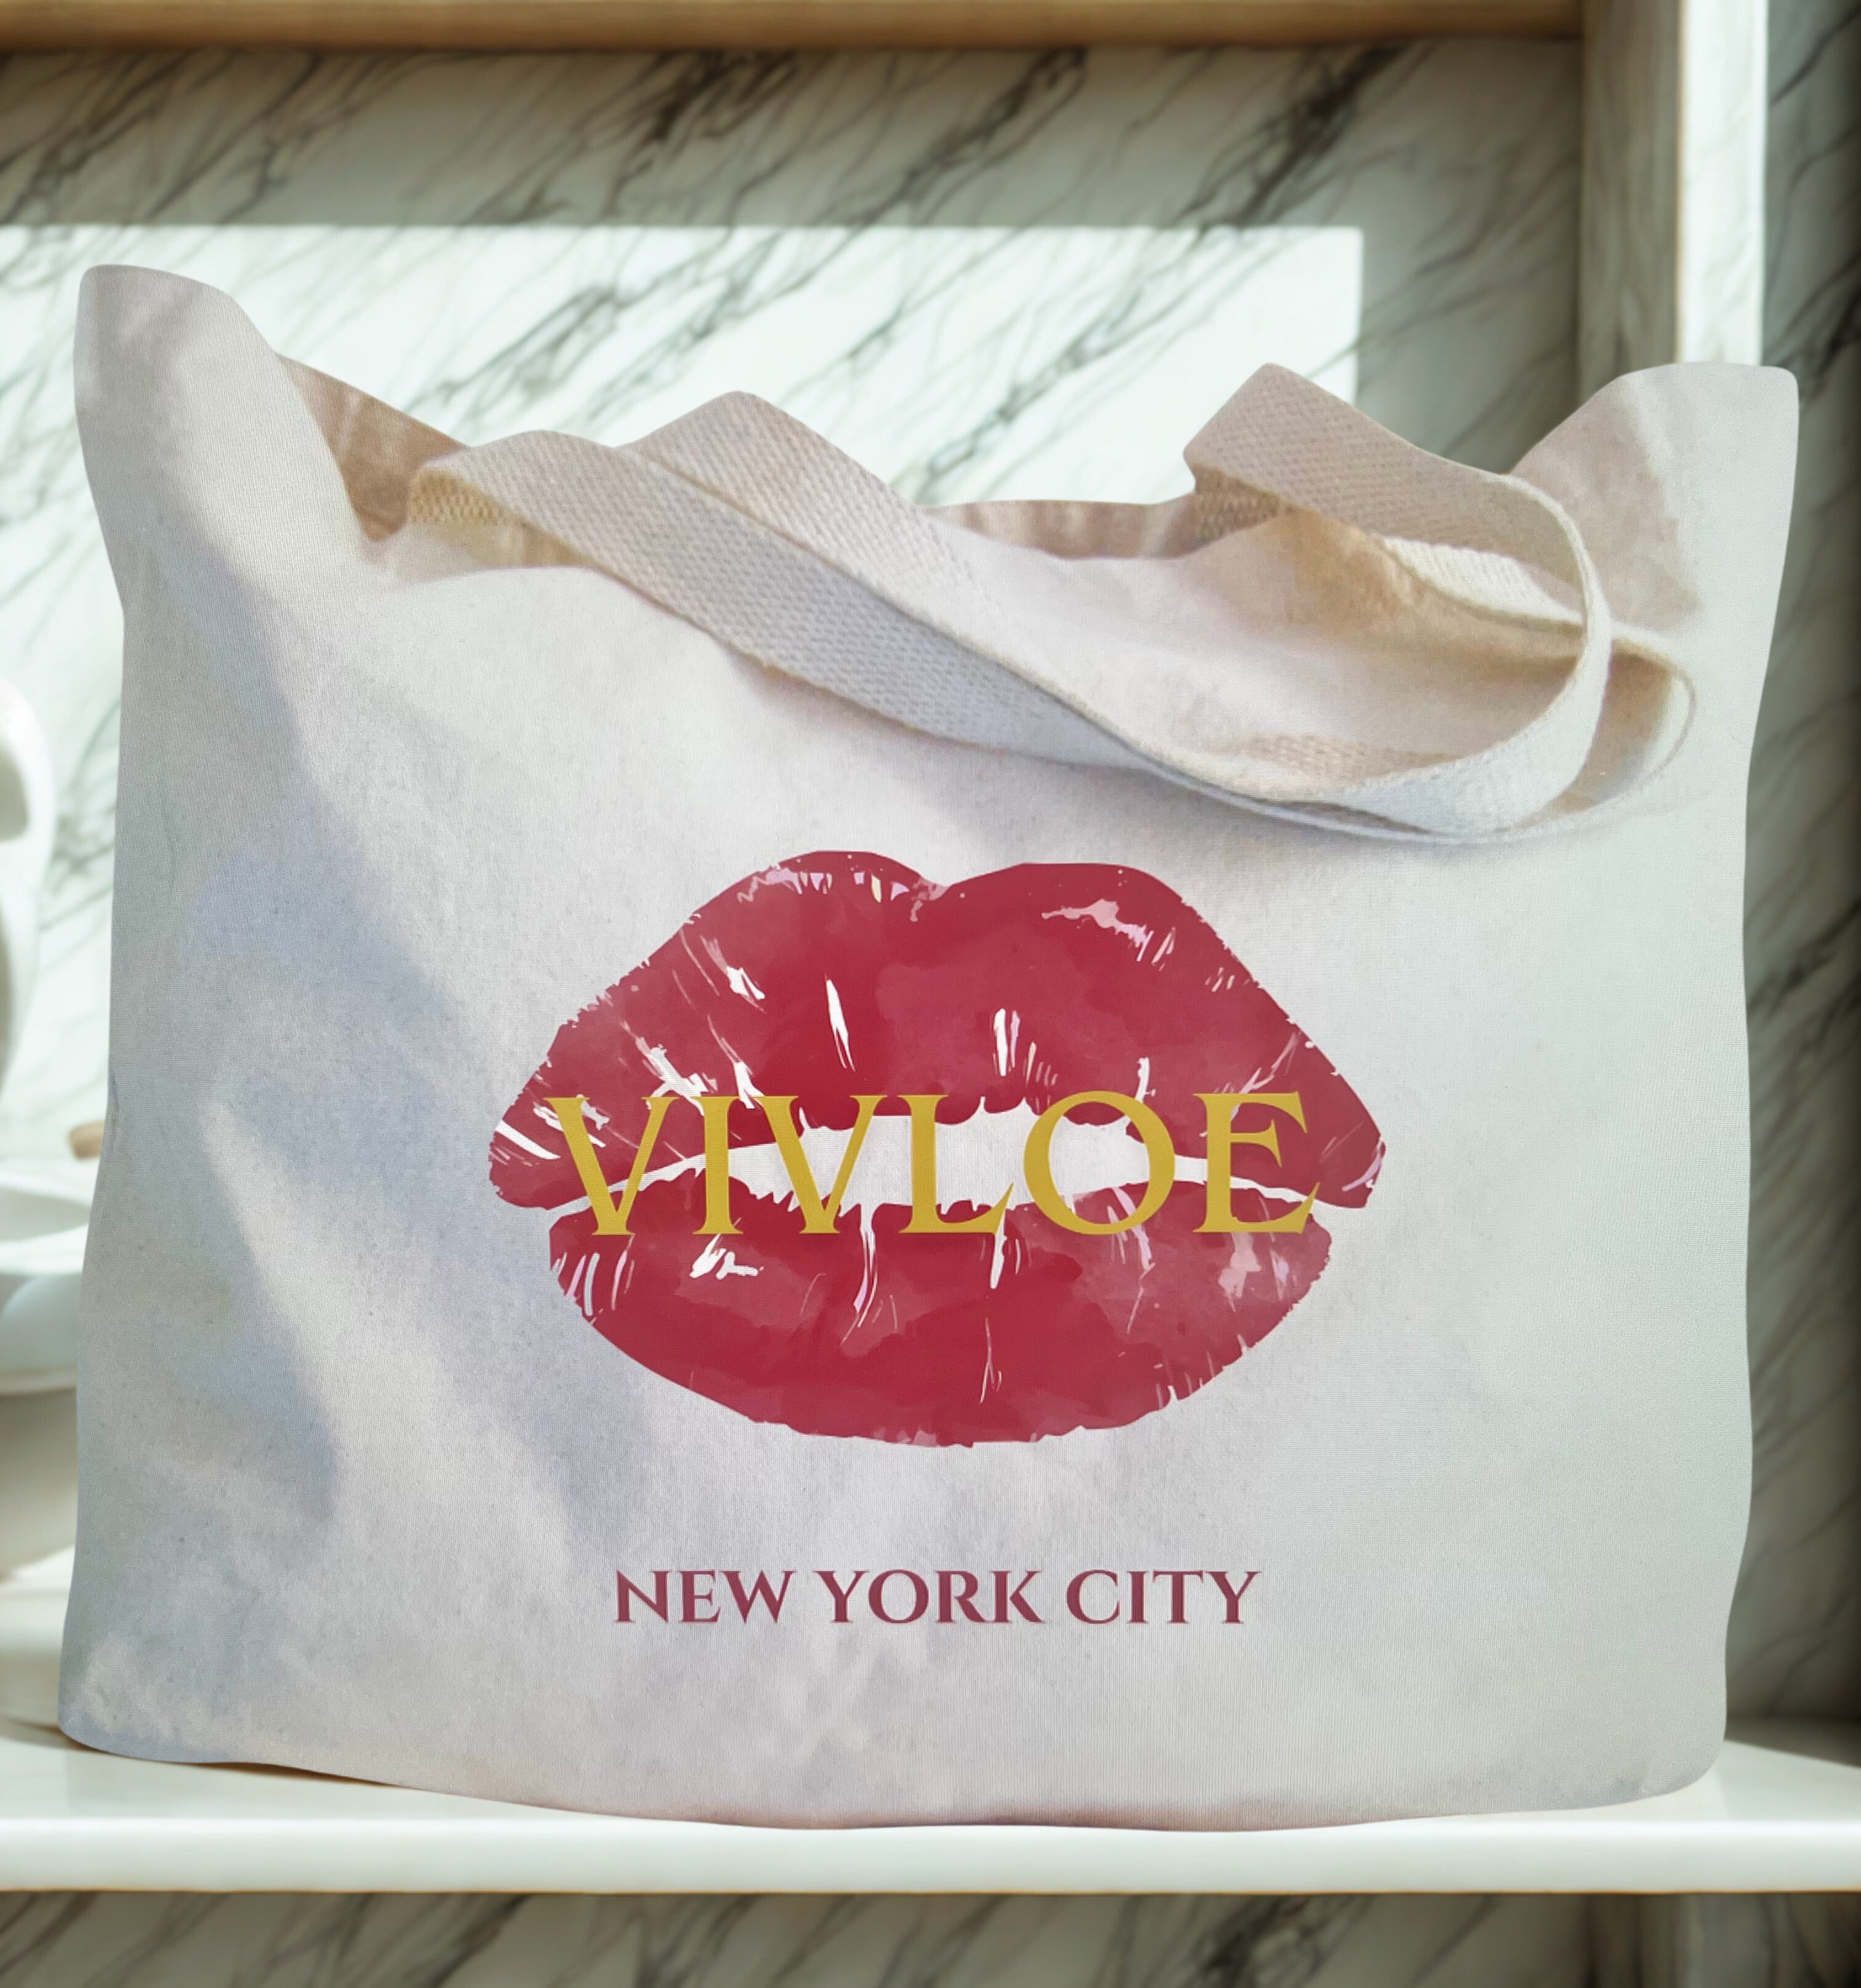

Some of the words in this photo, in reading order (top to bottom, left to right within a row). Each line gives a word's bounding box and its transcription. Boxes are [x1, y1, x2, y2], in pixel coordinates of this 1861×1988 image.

[544, 1090, 1320, 1235] VIVLOE
[614, 1569, 796, 1625] NEW
[812, 1569, 1044, 1625] YORK
[1066, 1569, 1262, 1625] CITY
